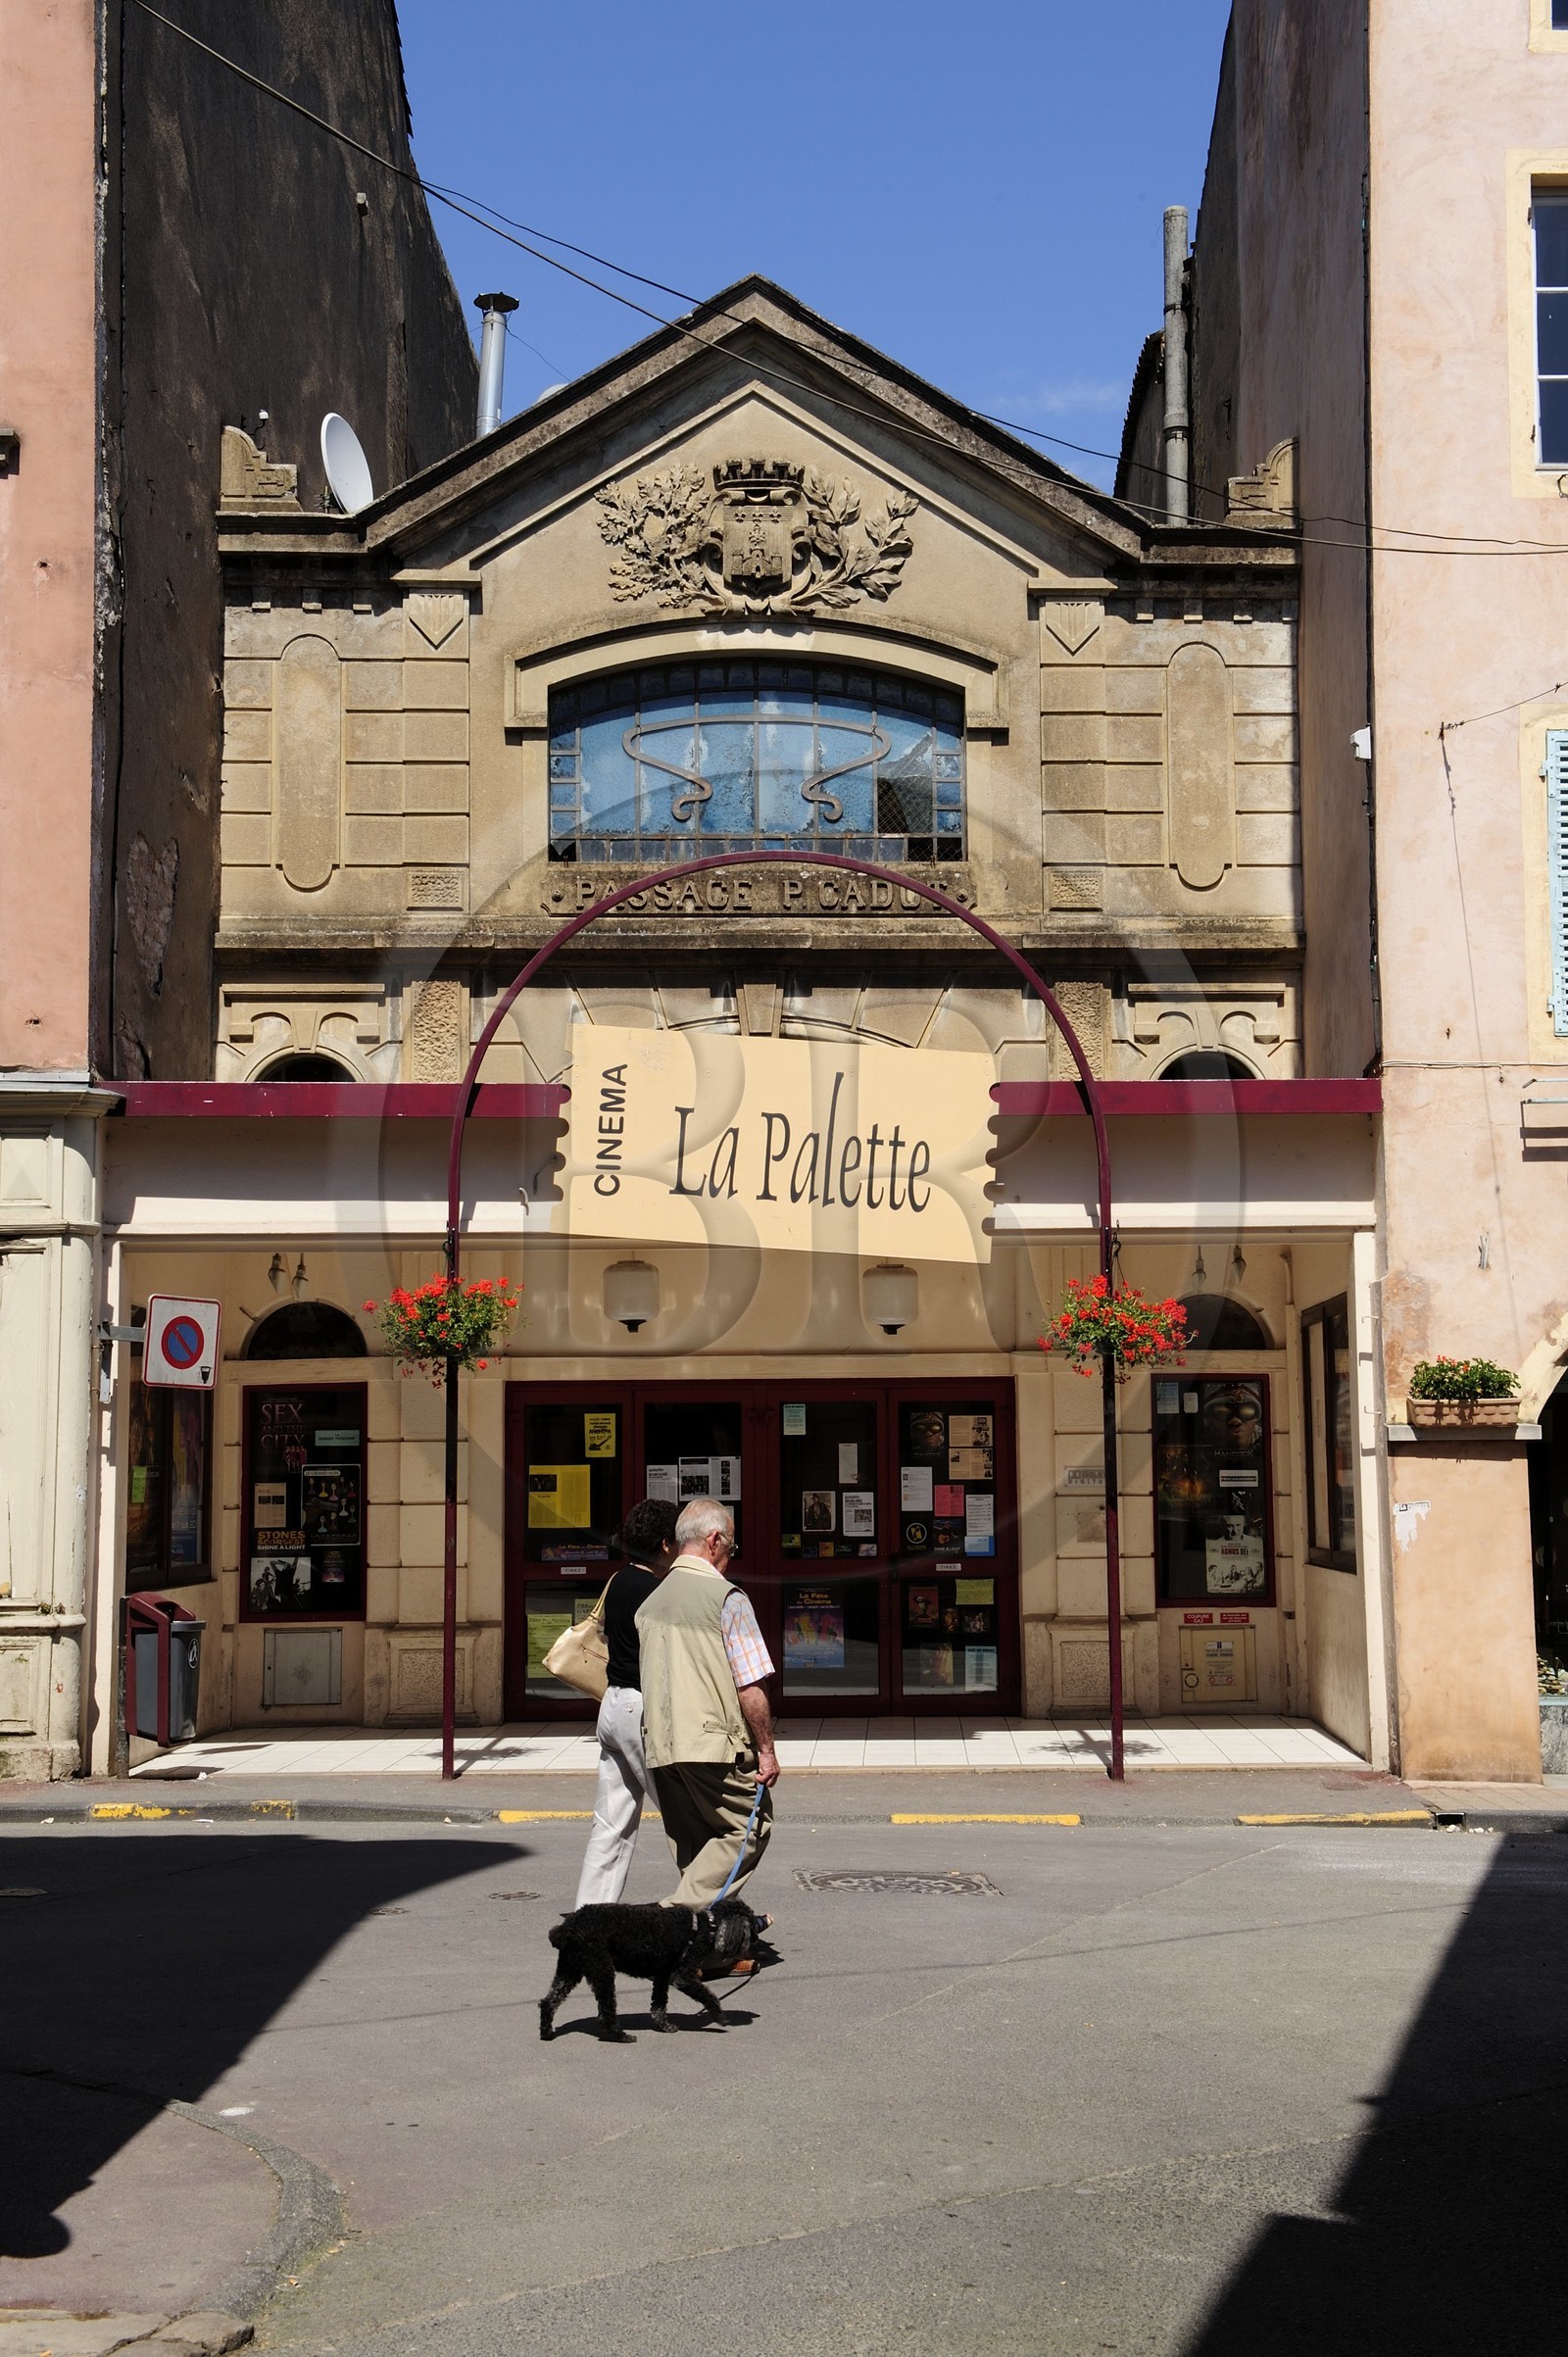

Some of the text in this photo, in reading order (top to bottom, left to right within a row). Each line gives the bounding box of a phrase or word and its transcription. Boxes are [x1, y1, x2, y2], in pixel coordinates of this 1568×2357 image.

[575, 880, 754, 909] PASSAGE
[594, 1063, 628, 1196] CINEMA
[668, 1071, 931, 1213] La Palette
[261, 1402, 304, 1424] SEX
[261, 1434, 305, 1449] CITY
[257, 1530, 306, 1539] STONES
